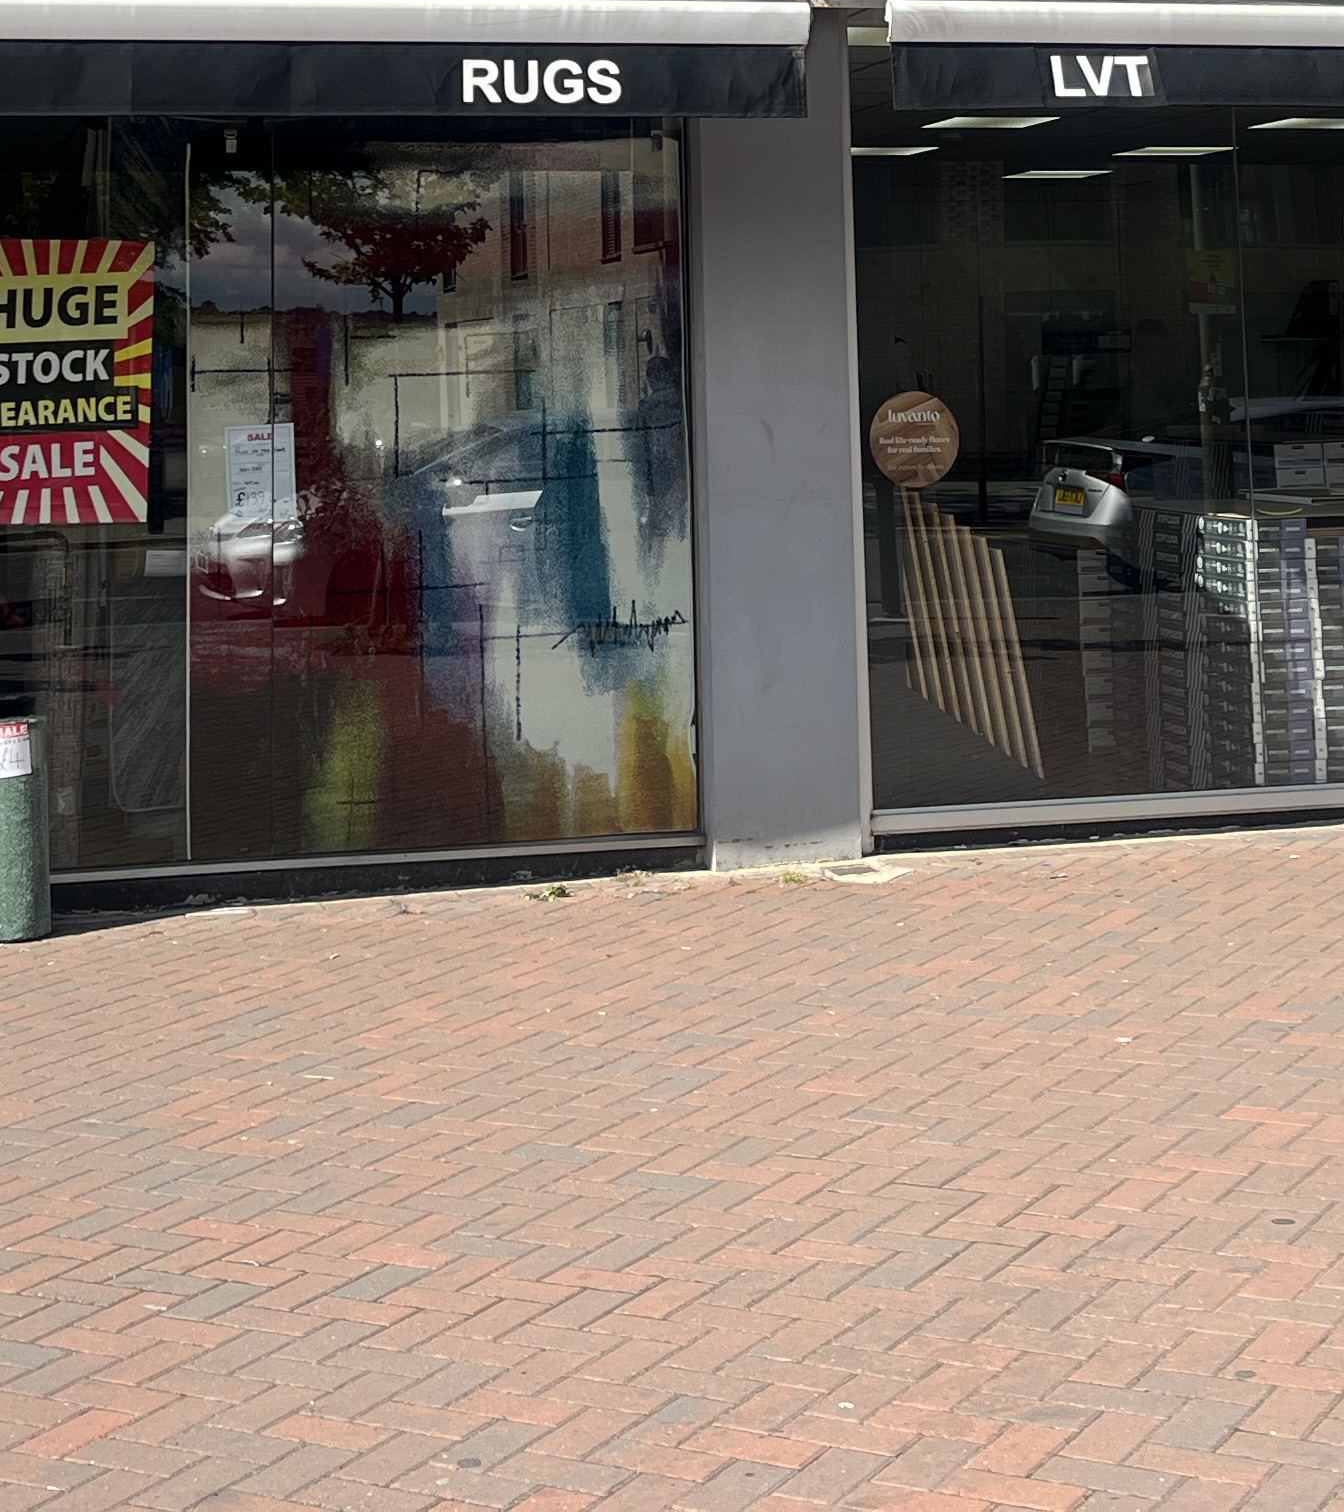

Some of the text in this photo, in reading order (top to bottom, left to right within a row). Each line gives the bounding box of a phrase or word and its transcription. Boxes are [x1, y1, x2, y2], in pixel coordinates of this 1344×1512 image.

[461, 58, 623, 105] RUGS
[1049, 54, 1150, 98] LVT
[887, 408, 941, 423] luvanto
